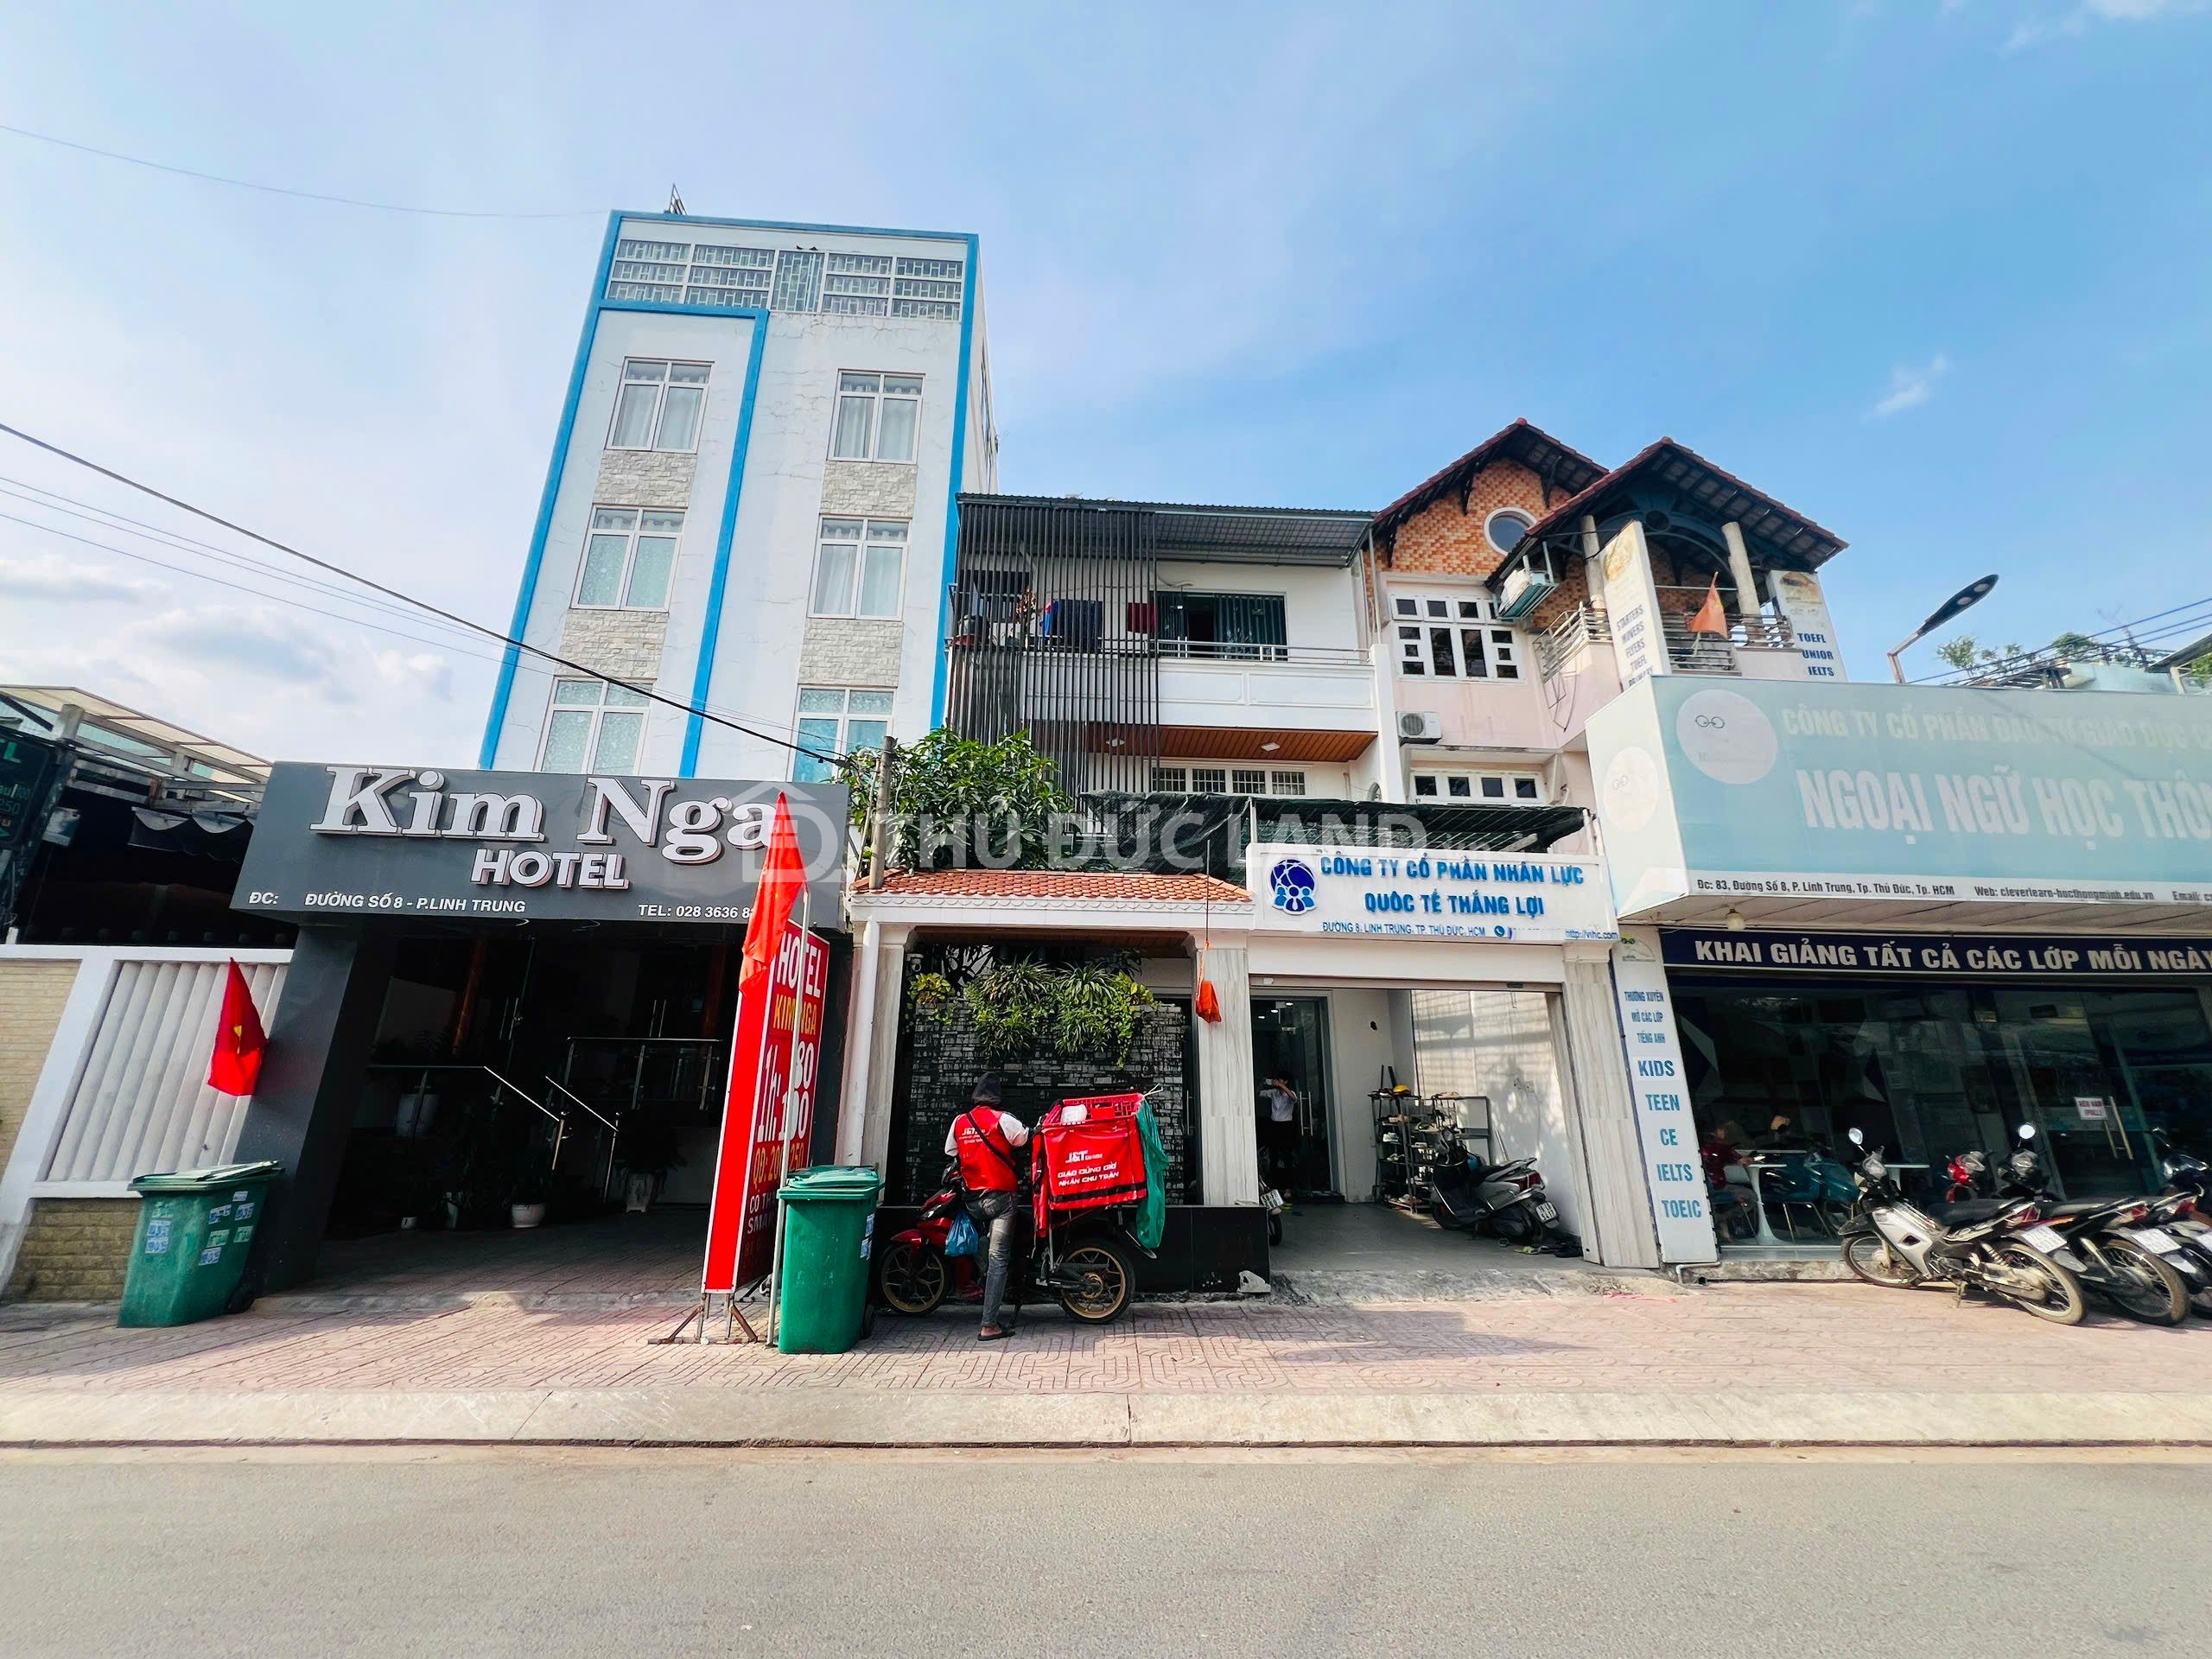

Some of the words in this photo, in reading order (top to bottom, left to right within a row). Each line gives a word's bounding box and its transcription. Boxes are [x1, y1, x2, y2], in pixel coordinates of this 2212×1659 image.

[1797, 632, 1827, 644] TOEFL
[1802, 649, 1834, 660] UNIOR
[1808, 666, 1834, 677] IELTS
[309, 766, 546, 842] Kim
[576, 776, 779, 864] Nga
[1795, 767, 1935, 844] NGOẠI
[1935, 764, 2030, 836] NGỮ
[2031, 777, 2125, 850] HỌC
[2123, 767, 2212, 840] THÔ
[471, 849, 630, 890] HOTEL
[1320, 852, 1372, 876] CÔNG
[1378, 859, 1400, 878] TY
[1493, 861, 1544, 882] NHÂN
[1550, 864, 1585, 887] LỰC
[1697, 880, 1713, 890] Đc:
[1765, 880, 1778, 892] Số
[1792, 881, 1801, 892] P.
[1802, 881, 1823, 893] Linh
[1825, 882, 1855, 894] Trung,
[1857, 882, 1872, 894] Tp.
[1873, 881, 1891, 893] Thủ
[1916, 884, 1931, 895] Tp.
[1933, 885, 1955, 895] HCM
[1974, 886, 1998, 898] Web:
[249, 892, 279, 905] ĐC:
[304, 891, 364, 907] ĐƯỜNG
[367, 891, 393, 907] SỐ
[394, 899, 403, 908] 8
[416, 899, 467, 911] P.LINH
[471, 899, 526, 912] TRUNG
[638, 904, 672, 917] TEL:
[676, 906, 701, 917] 028
[705, 906, 739, 918] 3636
[741, 907, 753, 918] 8
[1514, 895, 1544, 918] LỢI
[1364, 924, 1382, 933] LINH
[1468, 926, 1486, 937] HCM
[1694, 940, 1763, 963] KHAI
[1770, 938, 1858, 966] GIẢNG
[1863, 940, 1912, 968] TẤT
[1921, 943, 1961, 969] CẢ
[1966, 945, 2022, 969] CÁC
[2028, 945, 2079, 970] LỚP
[2088, 943, 2142, 970] MỖI
[1637, 1059, 1675, 1077] KIDS
[1645, 1094, 1681, 1111] TEEN
[1659, 1128, 1678, 1146] CE
[1065, 1150, 1089, 1164] J&T
[1058, 1169, 1077, 1179] GIAO
[1656, 1163, 1694, 1182] IELTS
[1662, 1199, 1702, 1218] TOEIC
